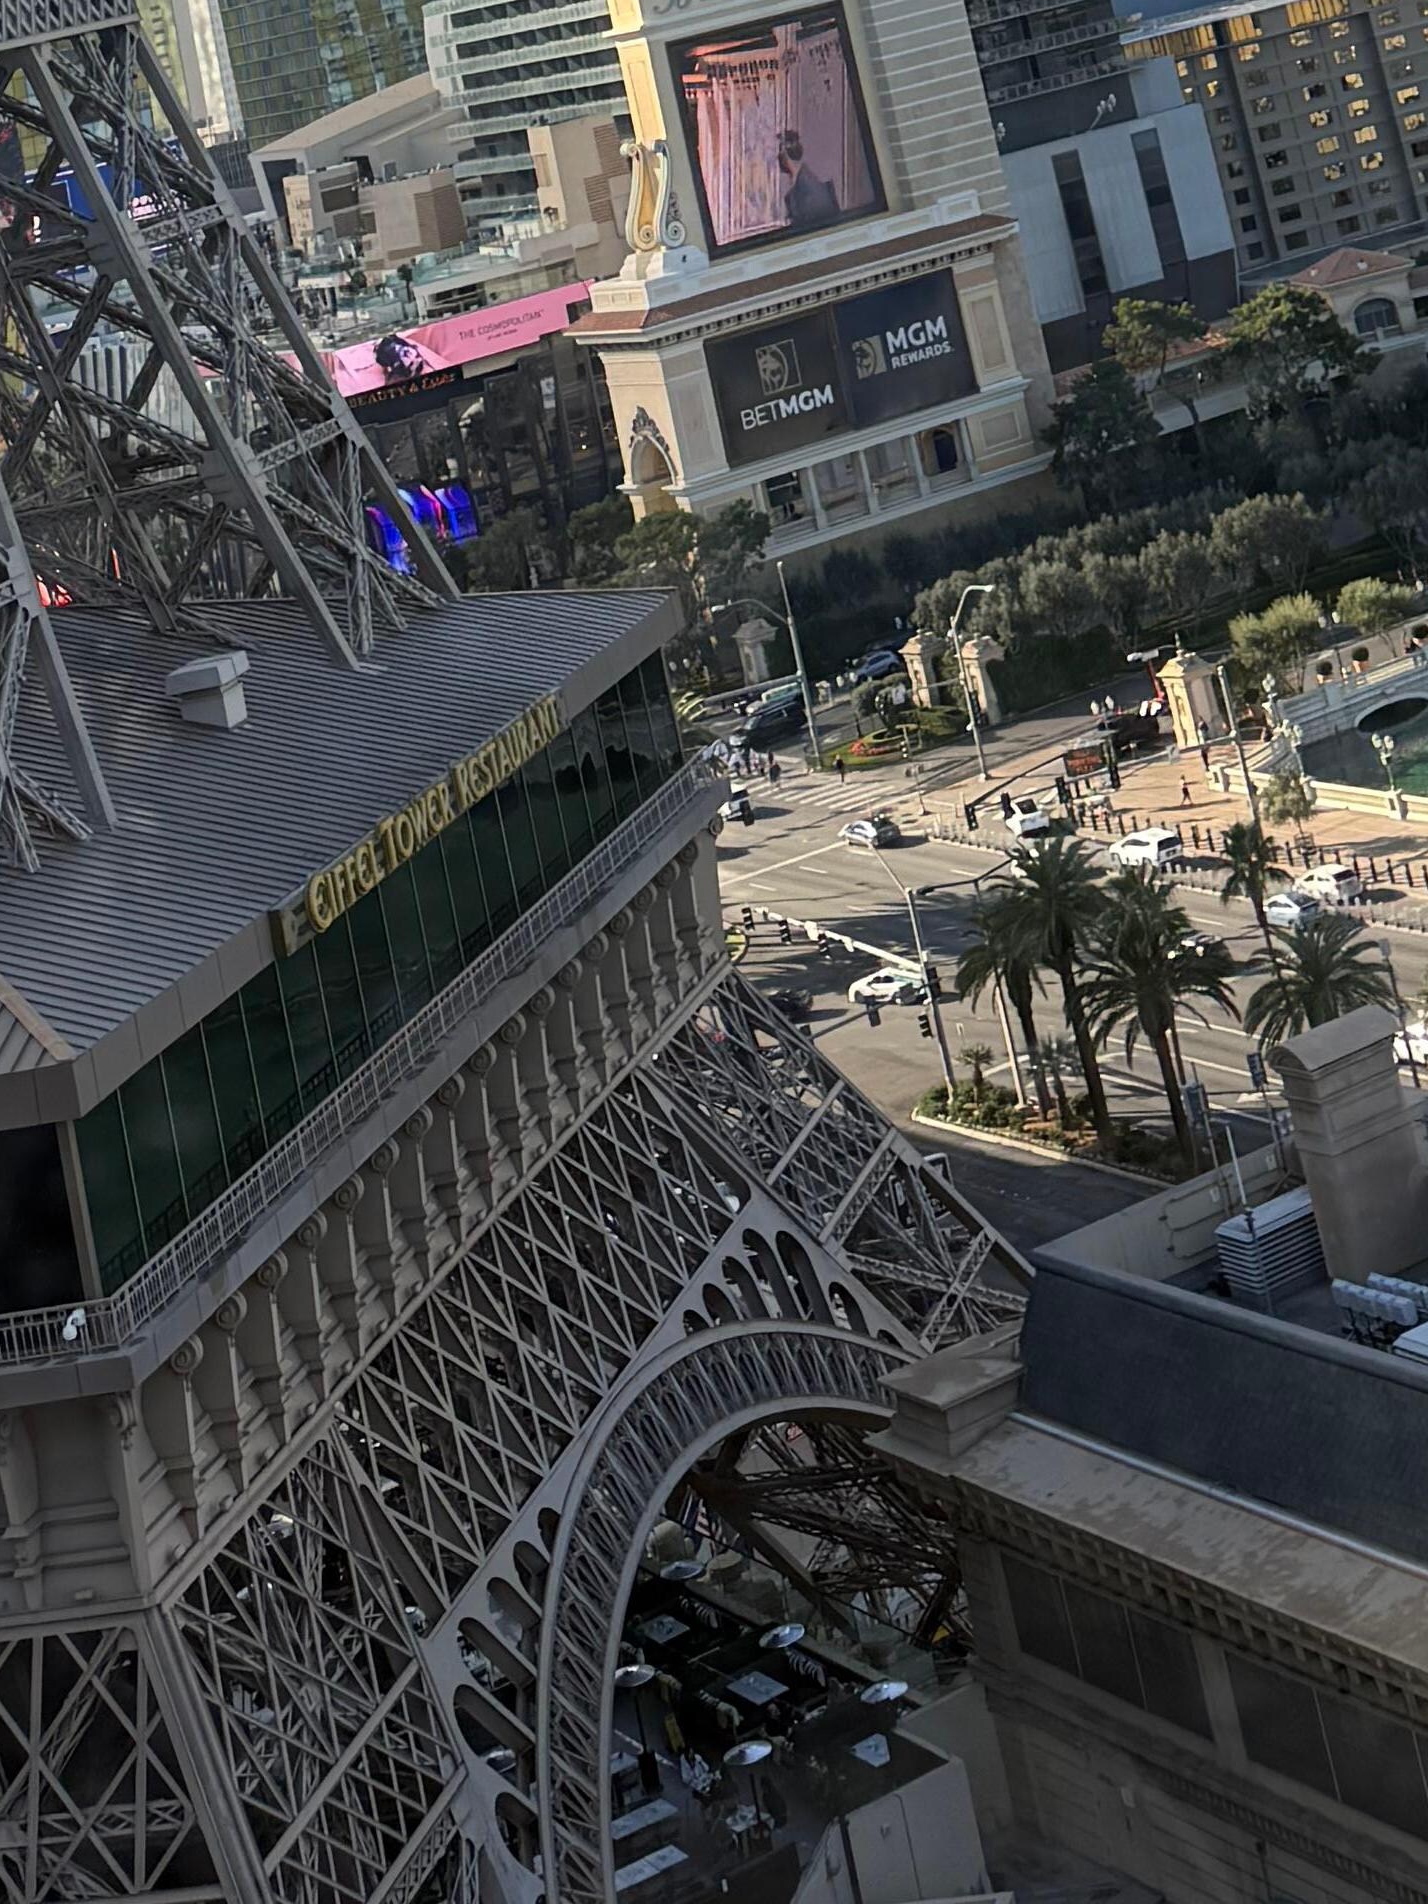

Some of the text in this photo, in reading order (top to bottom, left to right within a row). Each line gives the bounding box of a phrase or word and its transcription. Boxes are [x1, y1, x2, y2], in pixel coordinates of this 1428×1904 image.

[885, 315, 949, 354] MGM
[891, 341, 952, 369] REWARDS
[740, 384, 835, 431] BETMGM
[305, 694, 562, 933] EIFFEL TOWER RESTAURANT
